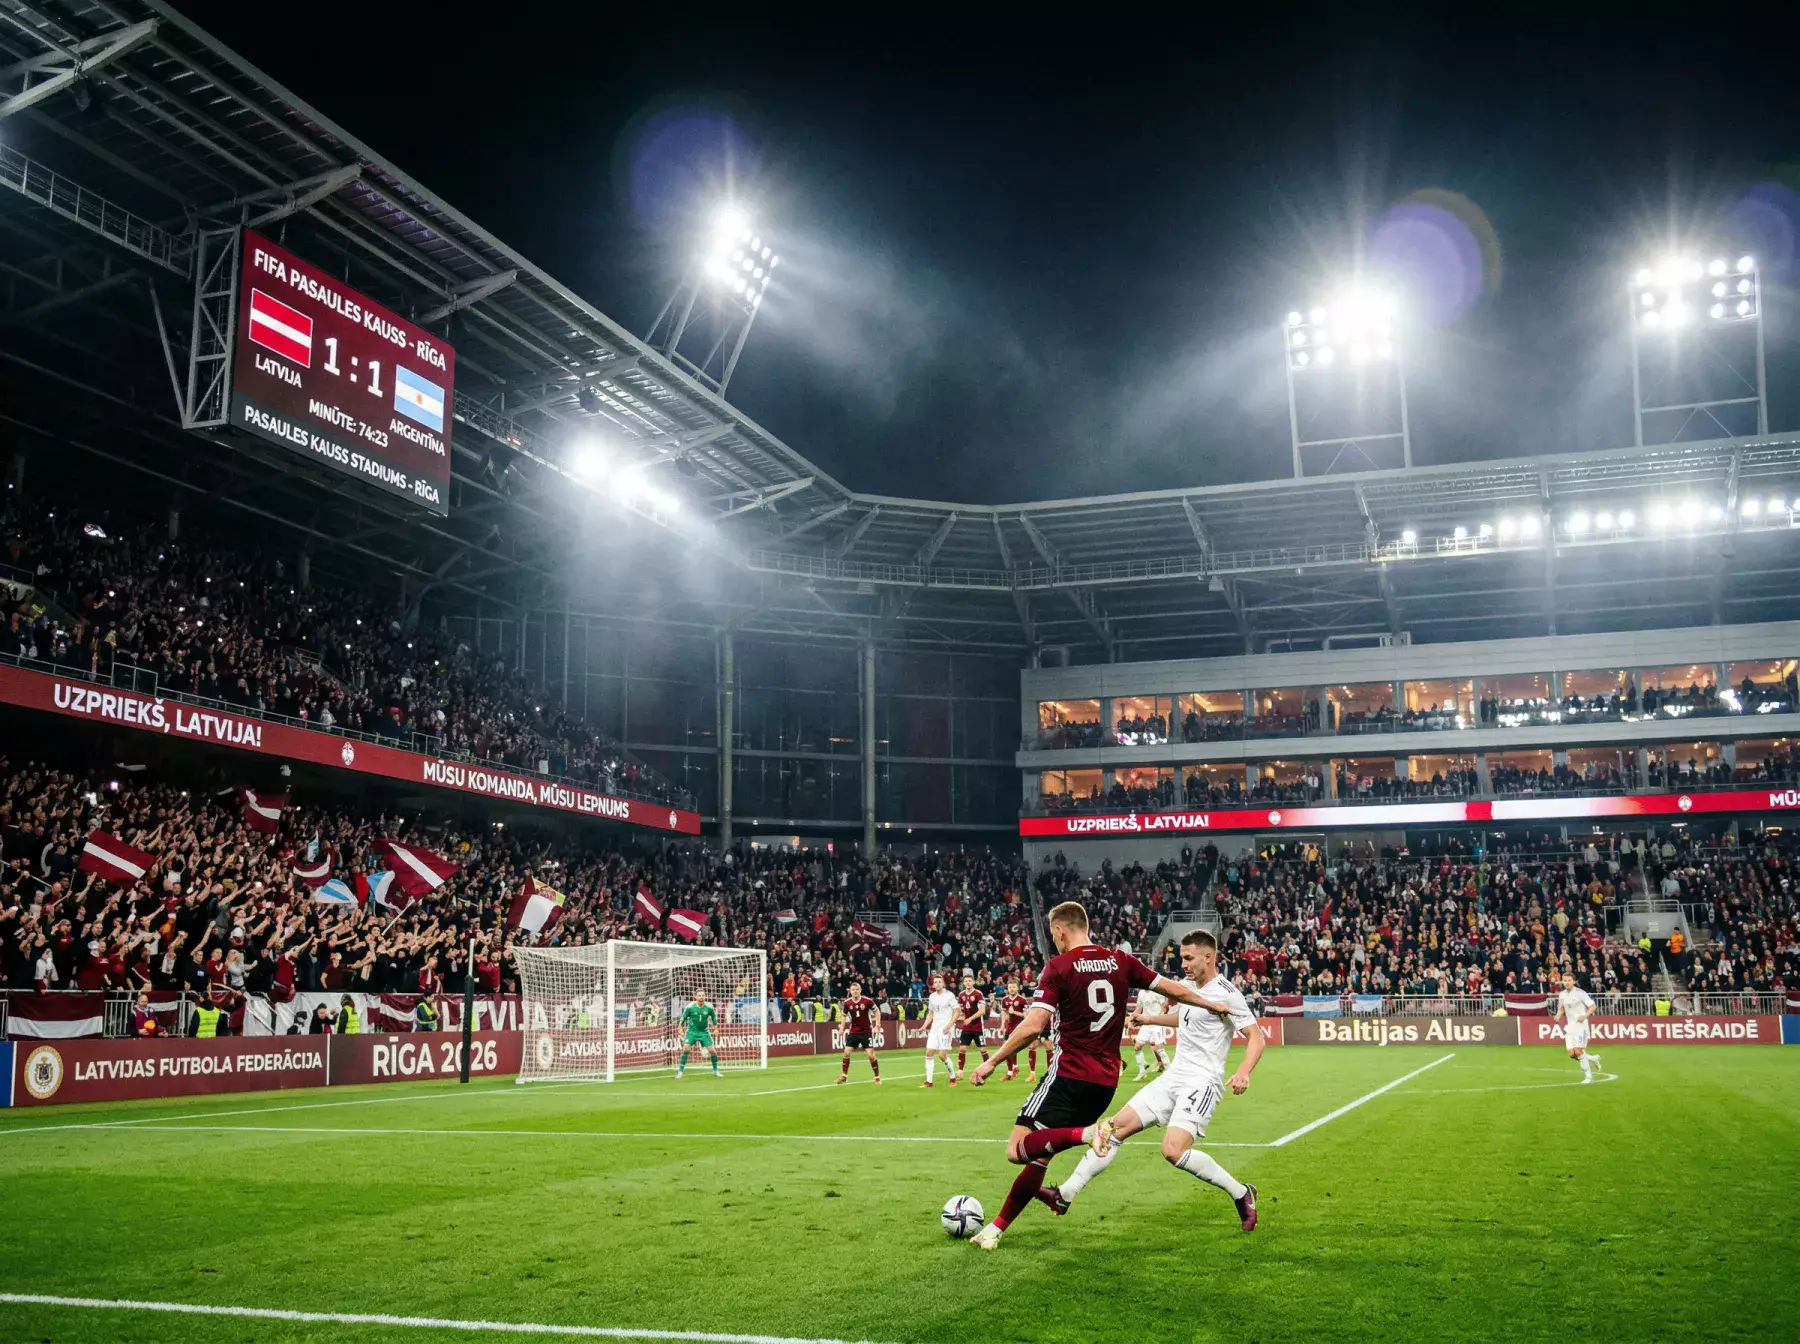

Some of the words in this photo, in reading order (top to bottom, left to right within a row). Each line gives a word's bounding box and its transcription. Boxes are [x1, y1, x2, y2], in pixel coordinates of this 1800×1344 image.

[254, 247, 287, 283] FIFA
[290, 268, 361, 323] PASAULES
[363, 310, 407, 348] KAUSS
[417, 340, 447, 372] RĪGA
[255, 353, 302, 388] LATVIJA
[309, 398, 357, 434] MINŪTE:
[358, 421, 389, 448] 74:23
[389, 418, 446, 457] ARGENTĪNA
[244, 404, 309, 447] PASAULES
[310, 434, 349, 464] KAUSS
[350, 452, 407, 489] STADIUMS
[414, 479, 440, 505] RĪGA
[53, 682, 171, 734] UZPRIEKŠ,
[175, 708, 262, 747] LATVIJA!
[423, 759, 465, 787] MŪSU
[467, 770, 537, 805] KOMANDA,
[540, 783, 575, 809] MŪSU
[577, 794, 630, 819] LEPNUMS
[1067, 812, 1142, 832] UZPRIEKŠ,
[1144, 815, 1209, 829] LATVIJA!
[1087, 979, 1115, 1032] 9
[1183, 1009, 1190, 1027] 4
[1318, 1019, 1419, 1046] Baltijas
[1424, 1018, 1485, 1041] Alus
[1538, 1023, 1648, 1039] PAKUMS
[1652, 1019, 1759, 1039] TIEŠRAIDĒ
[75, 1057, 155, 1081] LATVIJAS
[159, 1054, 233, 1076] FUTBOLA
[236, 1048, 322, 1073] FEDERĀCIJA
[372, 1036, 436, 1077] RĪGA
[1187, 1089, 1199, 1105] 4
